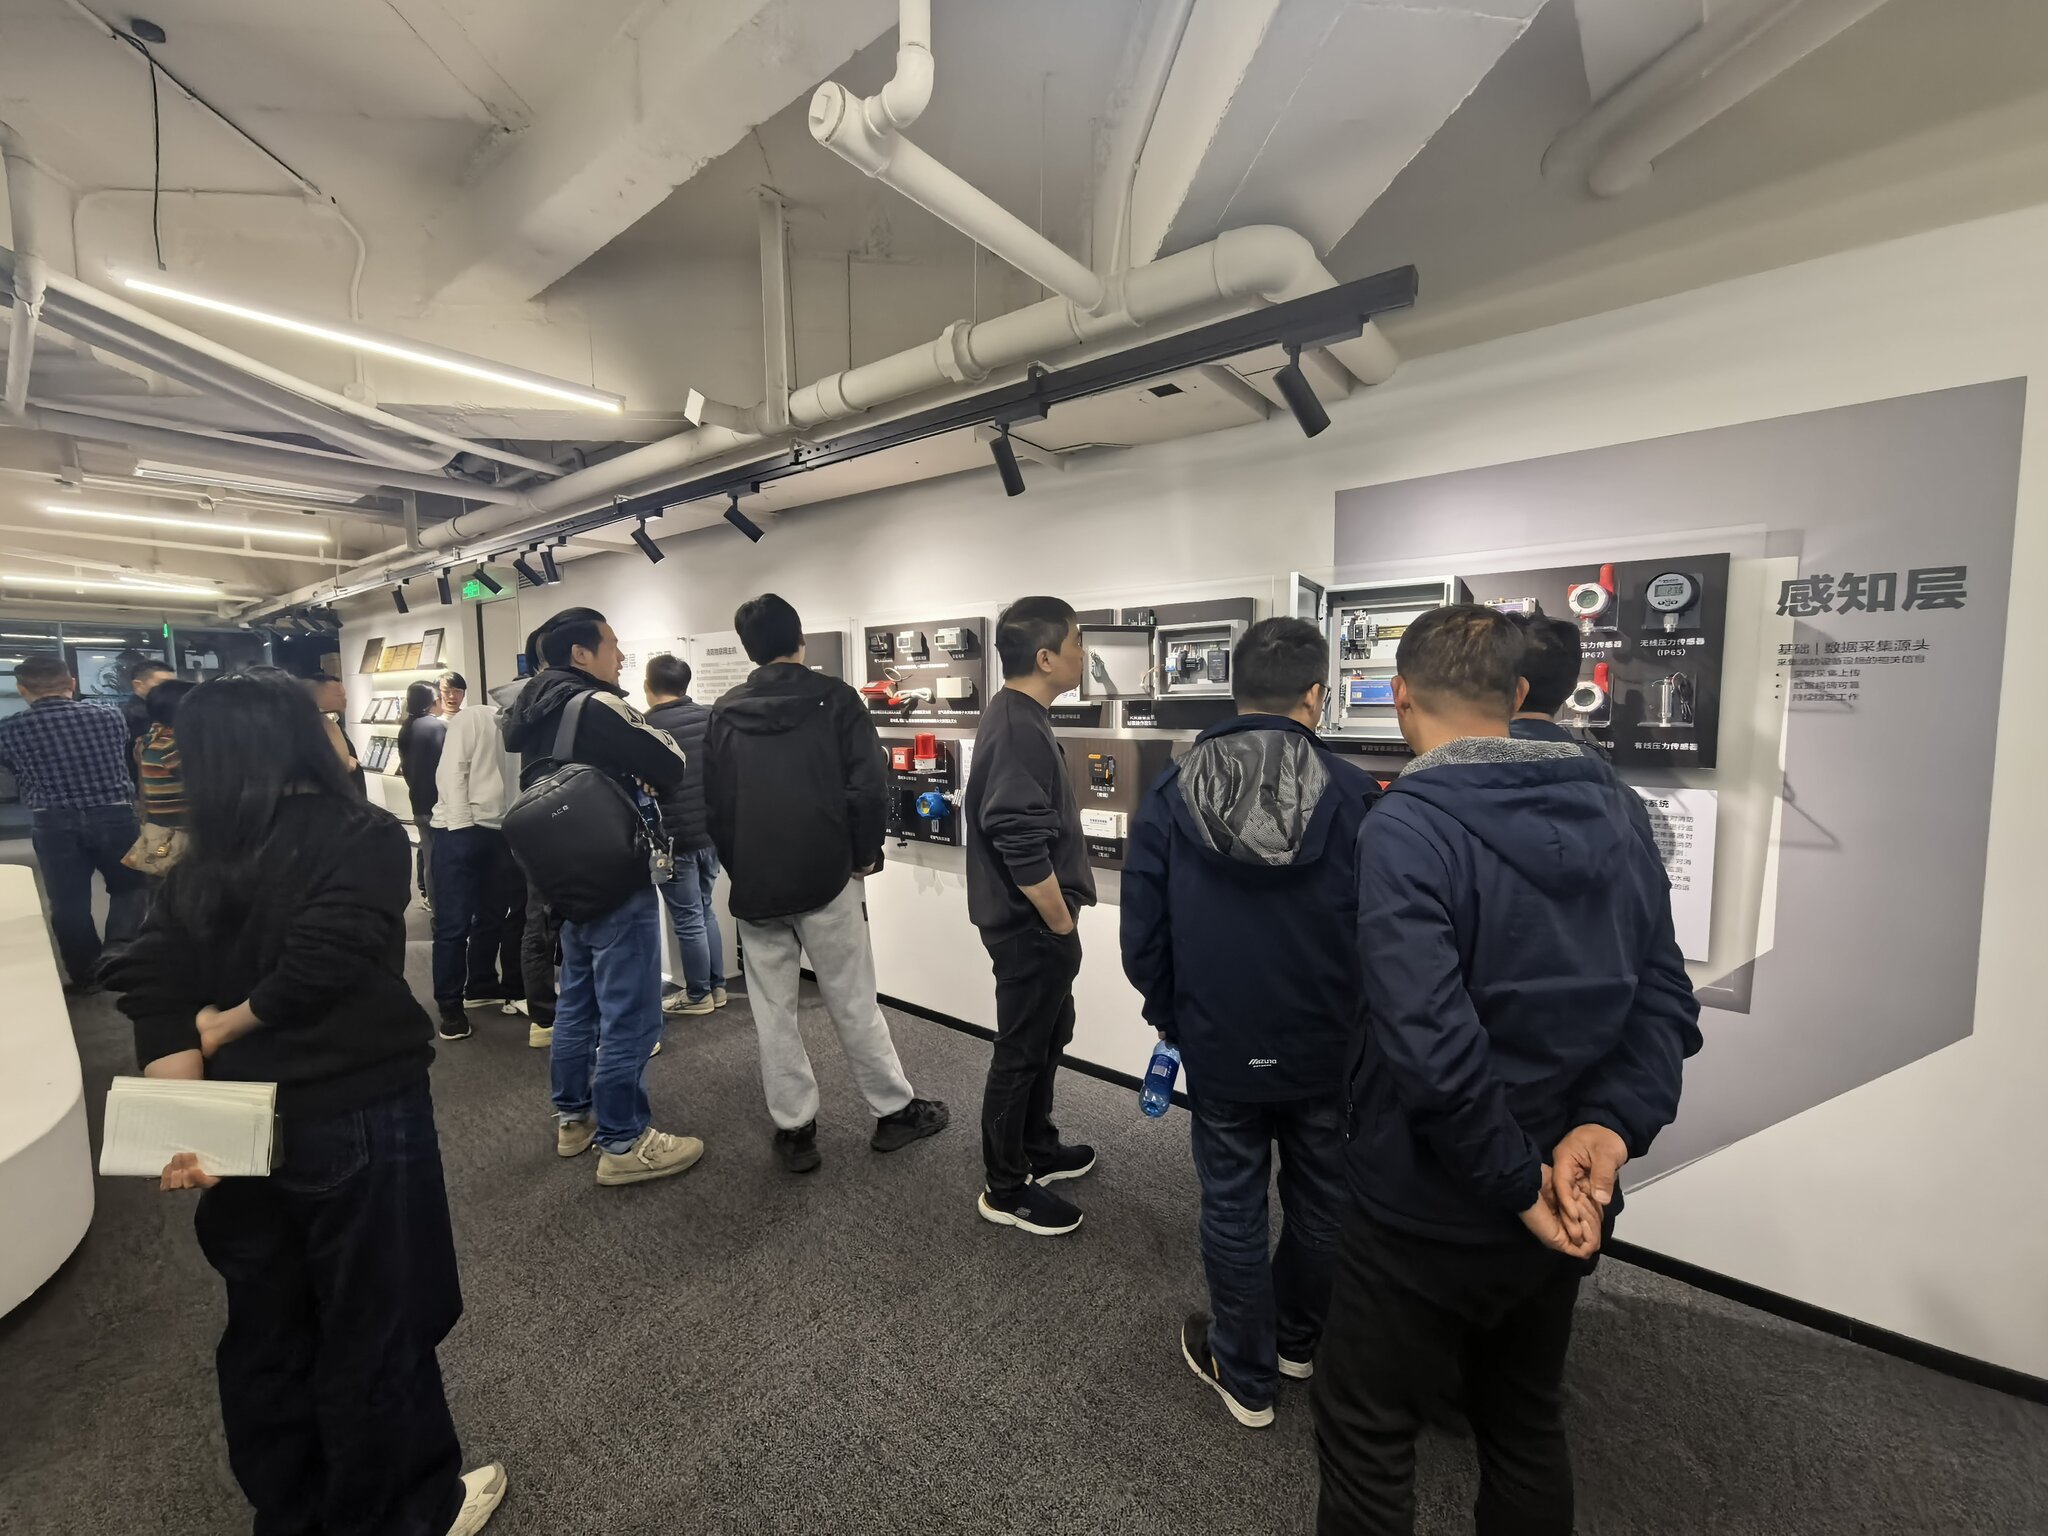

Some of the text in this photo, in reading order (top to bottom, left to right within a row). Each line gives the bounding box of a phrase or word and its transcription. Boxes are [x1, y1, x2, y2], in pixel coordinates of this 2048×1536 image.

[1776, 566, 1968, 617] 感知层
[1640, 638, 1705, 647] 无线压力传感器
[1634, 742, 1698, 751] 有线压力传感器
